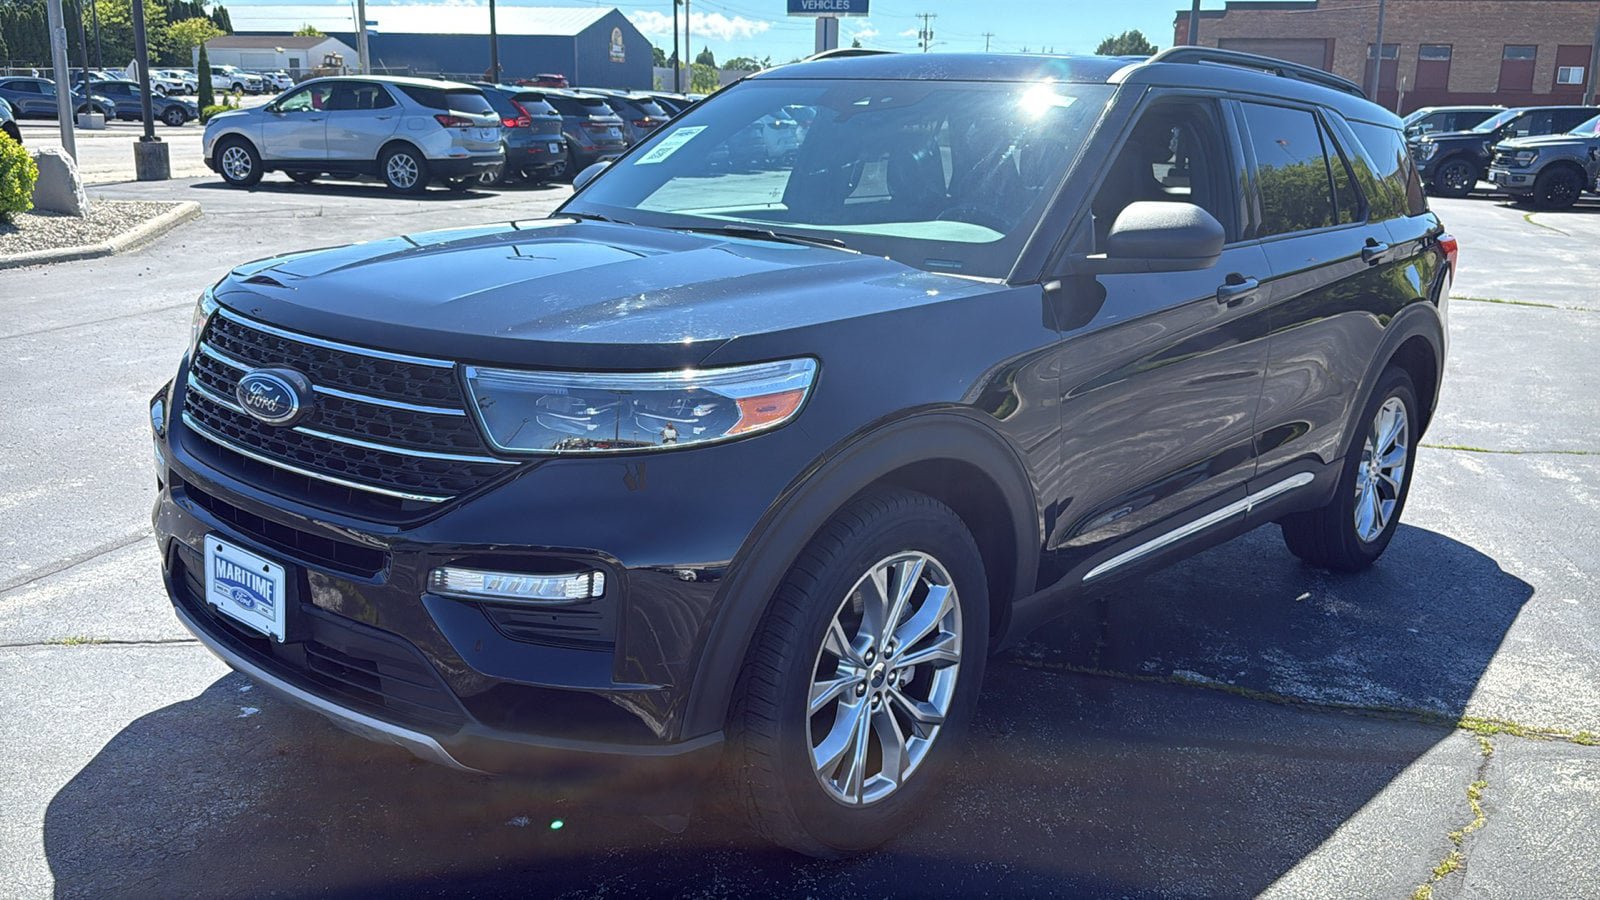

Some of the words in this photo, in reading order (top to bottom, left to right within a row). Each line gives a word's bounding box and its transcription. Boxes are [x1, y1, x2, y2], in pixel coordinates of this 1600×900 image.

[801, 0, 850, 10] VEHICLES
[246, 381, 281, 412] Ford
[215, 557, 273, 604] MARITIME
[235, 591, 252, 607] Ford
